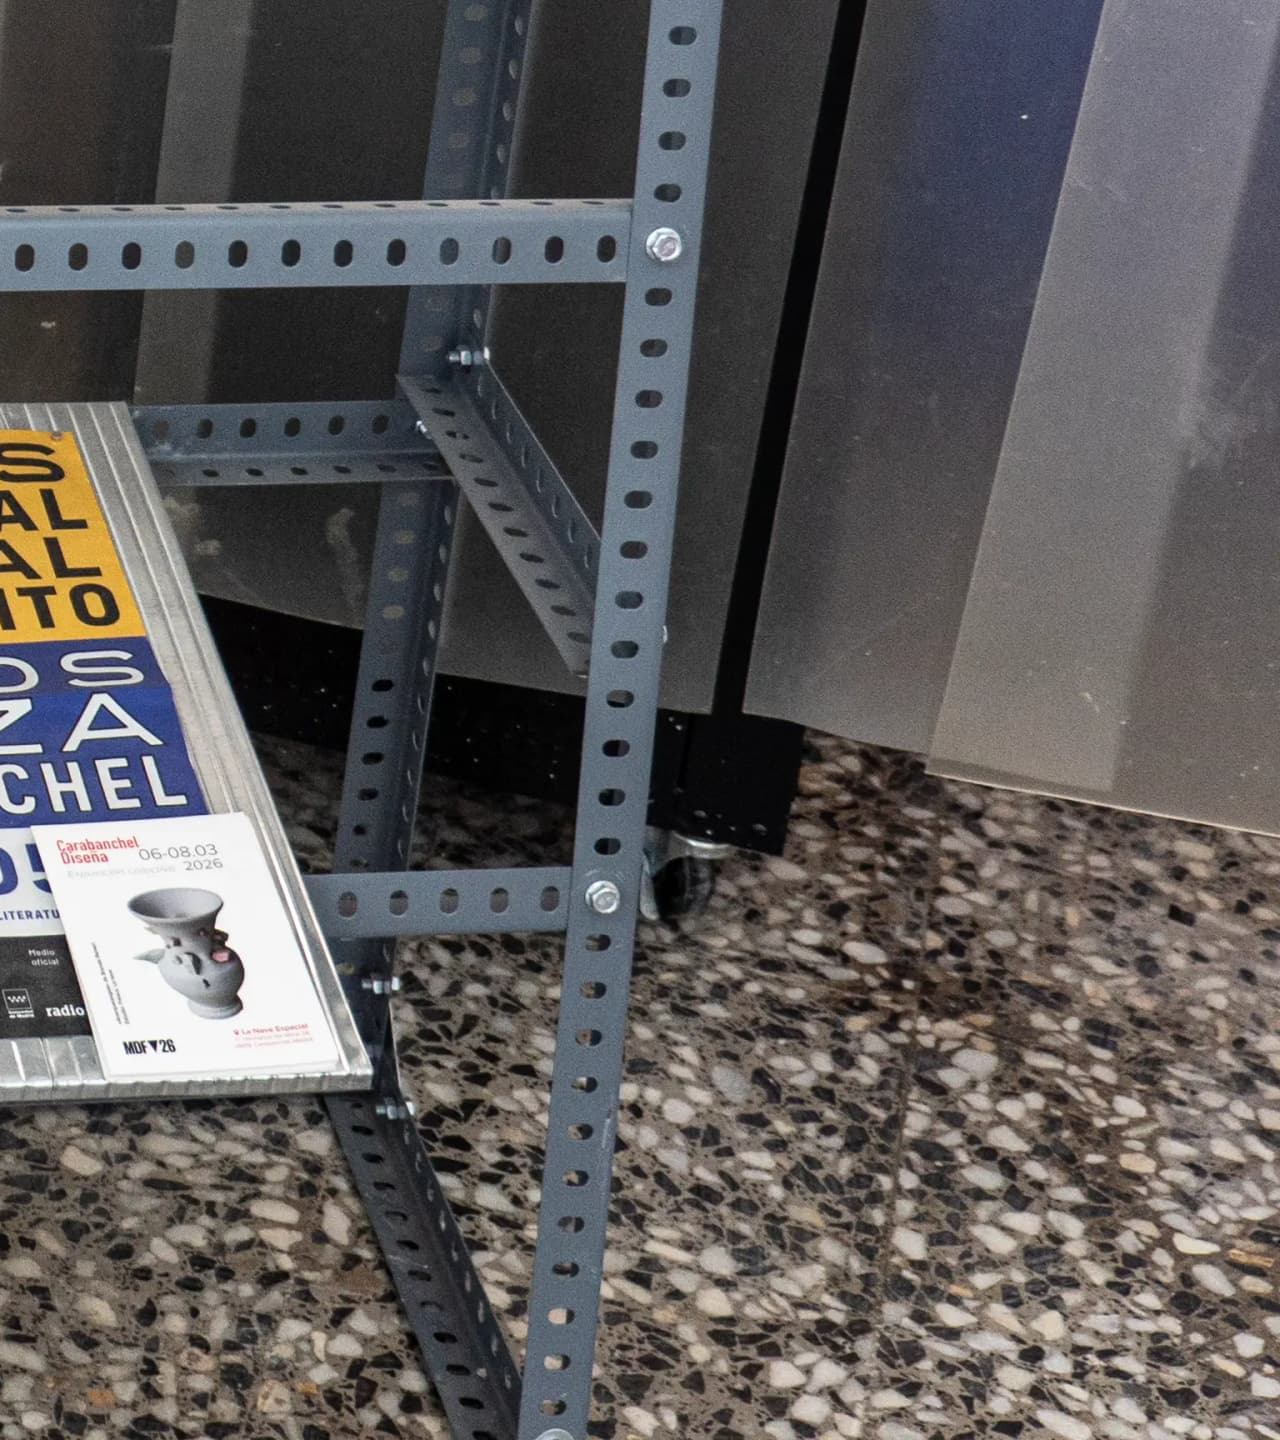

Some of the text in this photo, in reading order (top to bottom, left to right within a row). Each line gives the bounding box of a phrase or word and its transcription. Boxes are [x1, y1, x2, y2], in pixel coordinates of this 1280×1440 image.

[56, 836, 140, 851] Carabanchel
[61, 851, 109, 864] Diseña
[139, 843, 218, 861] 06-08.03
[183, 858, 224, 871] 2026
[28, 949, 56, 957] Medio
[31, 958, 59, 966] oficial
[45, 1005, 85, 1017] radio
[123, 1039, 176, 1055] MDF 26
